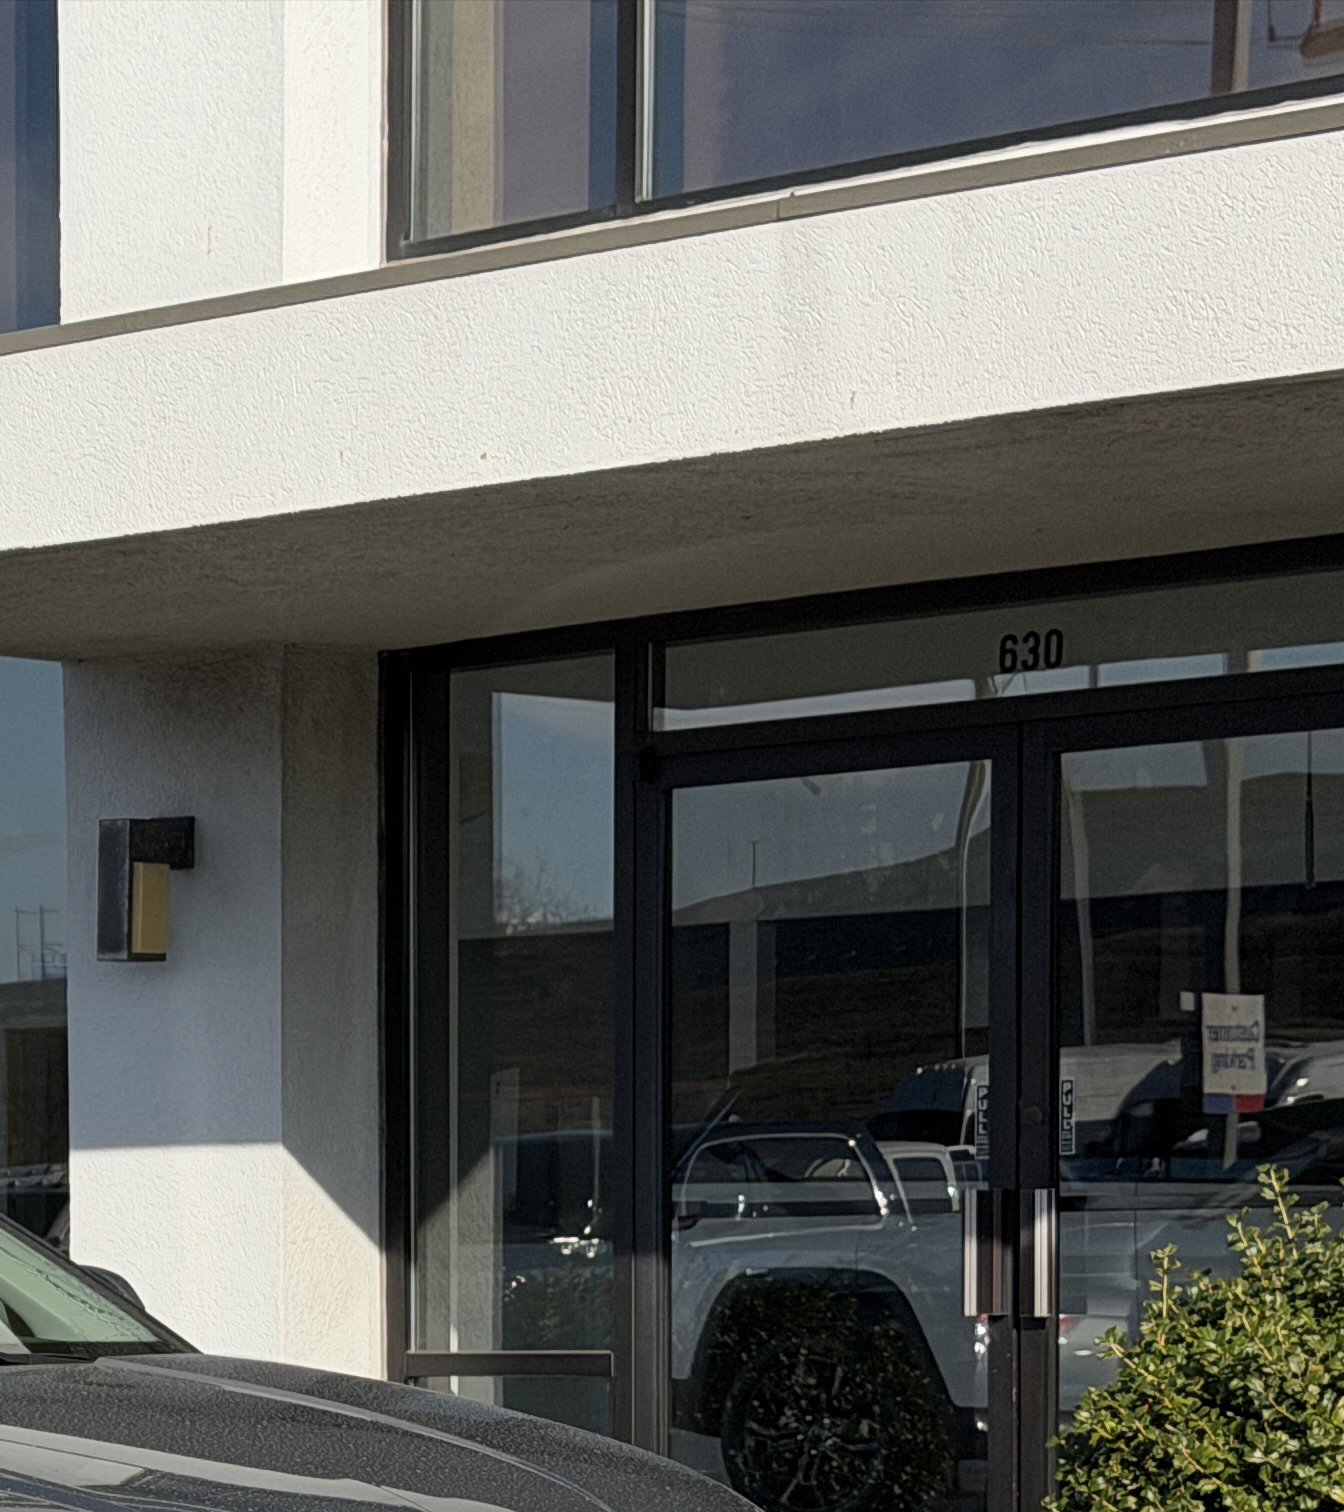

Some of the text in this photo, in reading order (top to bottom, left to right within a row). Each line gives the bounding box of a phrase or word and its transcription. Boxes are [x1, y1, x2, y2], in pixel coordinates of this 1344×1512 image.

[999, 628, 1064, 673] 630
[978, 1087, 989, 1134] PULL
[1062, 1082, 1072, 1130] PULL
